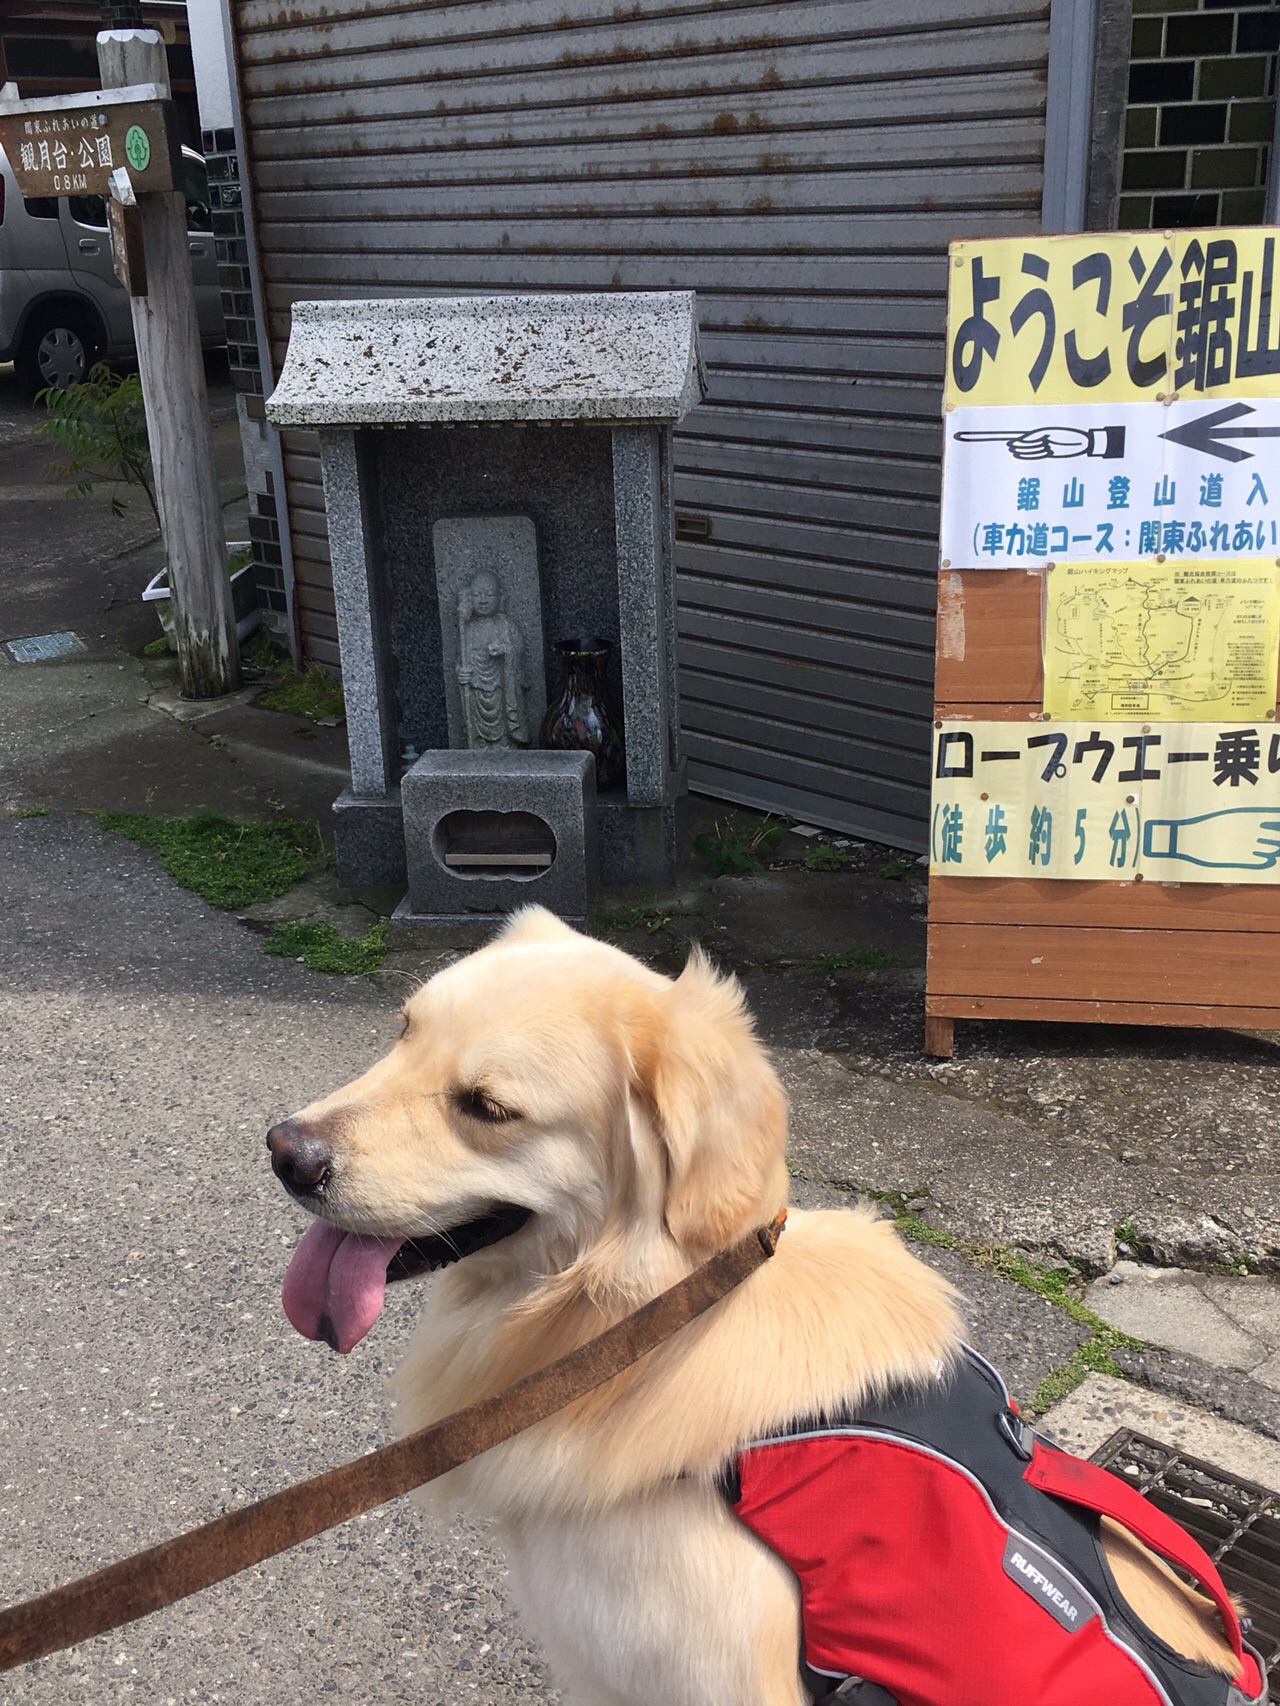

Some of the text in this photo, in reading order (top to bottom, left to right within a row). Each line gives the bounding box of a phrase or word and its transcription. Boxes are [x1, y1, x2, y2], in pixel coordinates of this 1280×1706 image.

[952, 237, 1280, 393] ようこそ鋸山
[1010, 1552, 1078, 1622] RUFFWEAR
